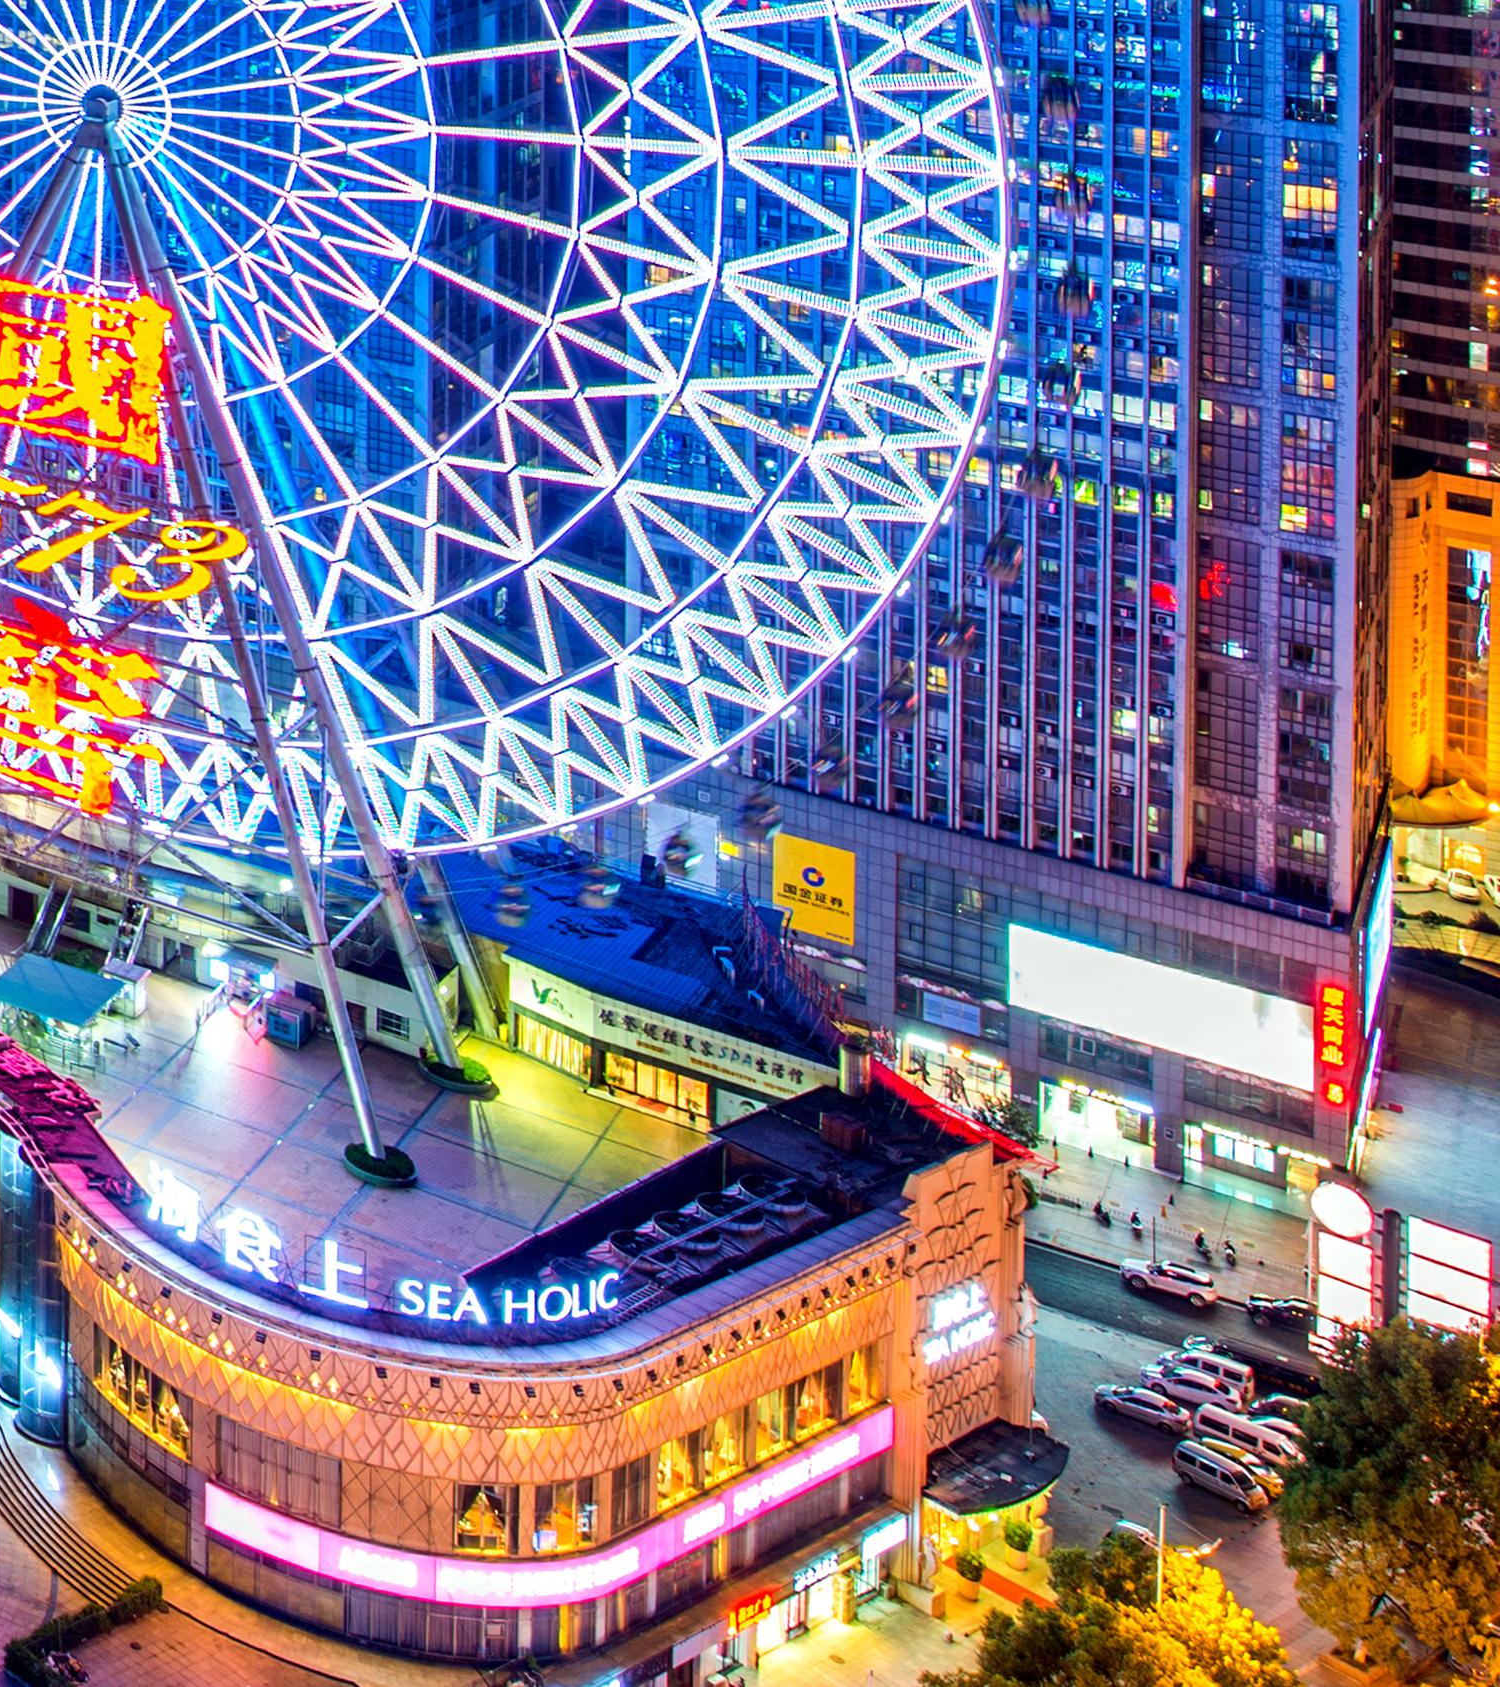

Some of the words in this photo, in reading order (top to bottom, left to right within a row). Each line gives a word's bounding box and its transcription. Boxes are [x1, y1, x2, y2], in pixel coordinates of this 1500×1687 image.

[783, 882, 844, 909] 国金证券
[400, 1279, 489, 1325] SEA
[503, 1271, 621, 1325] HOLIC
